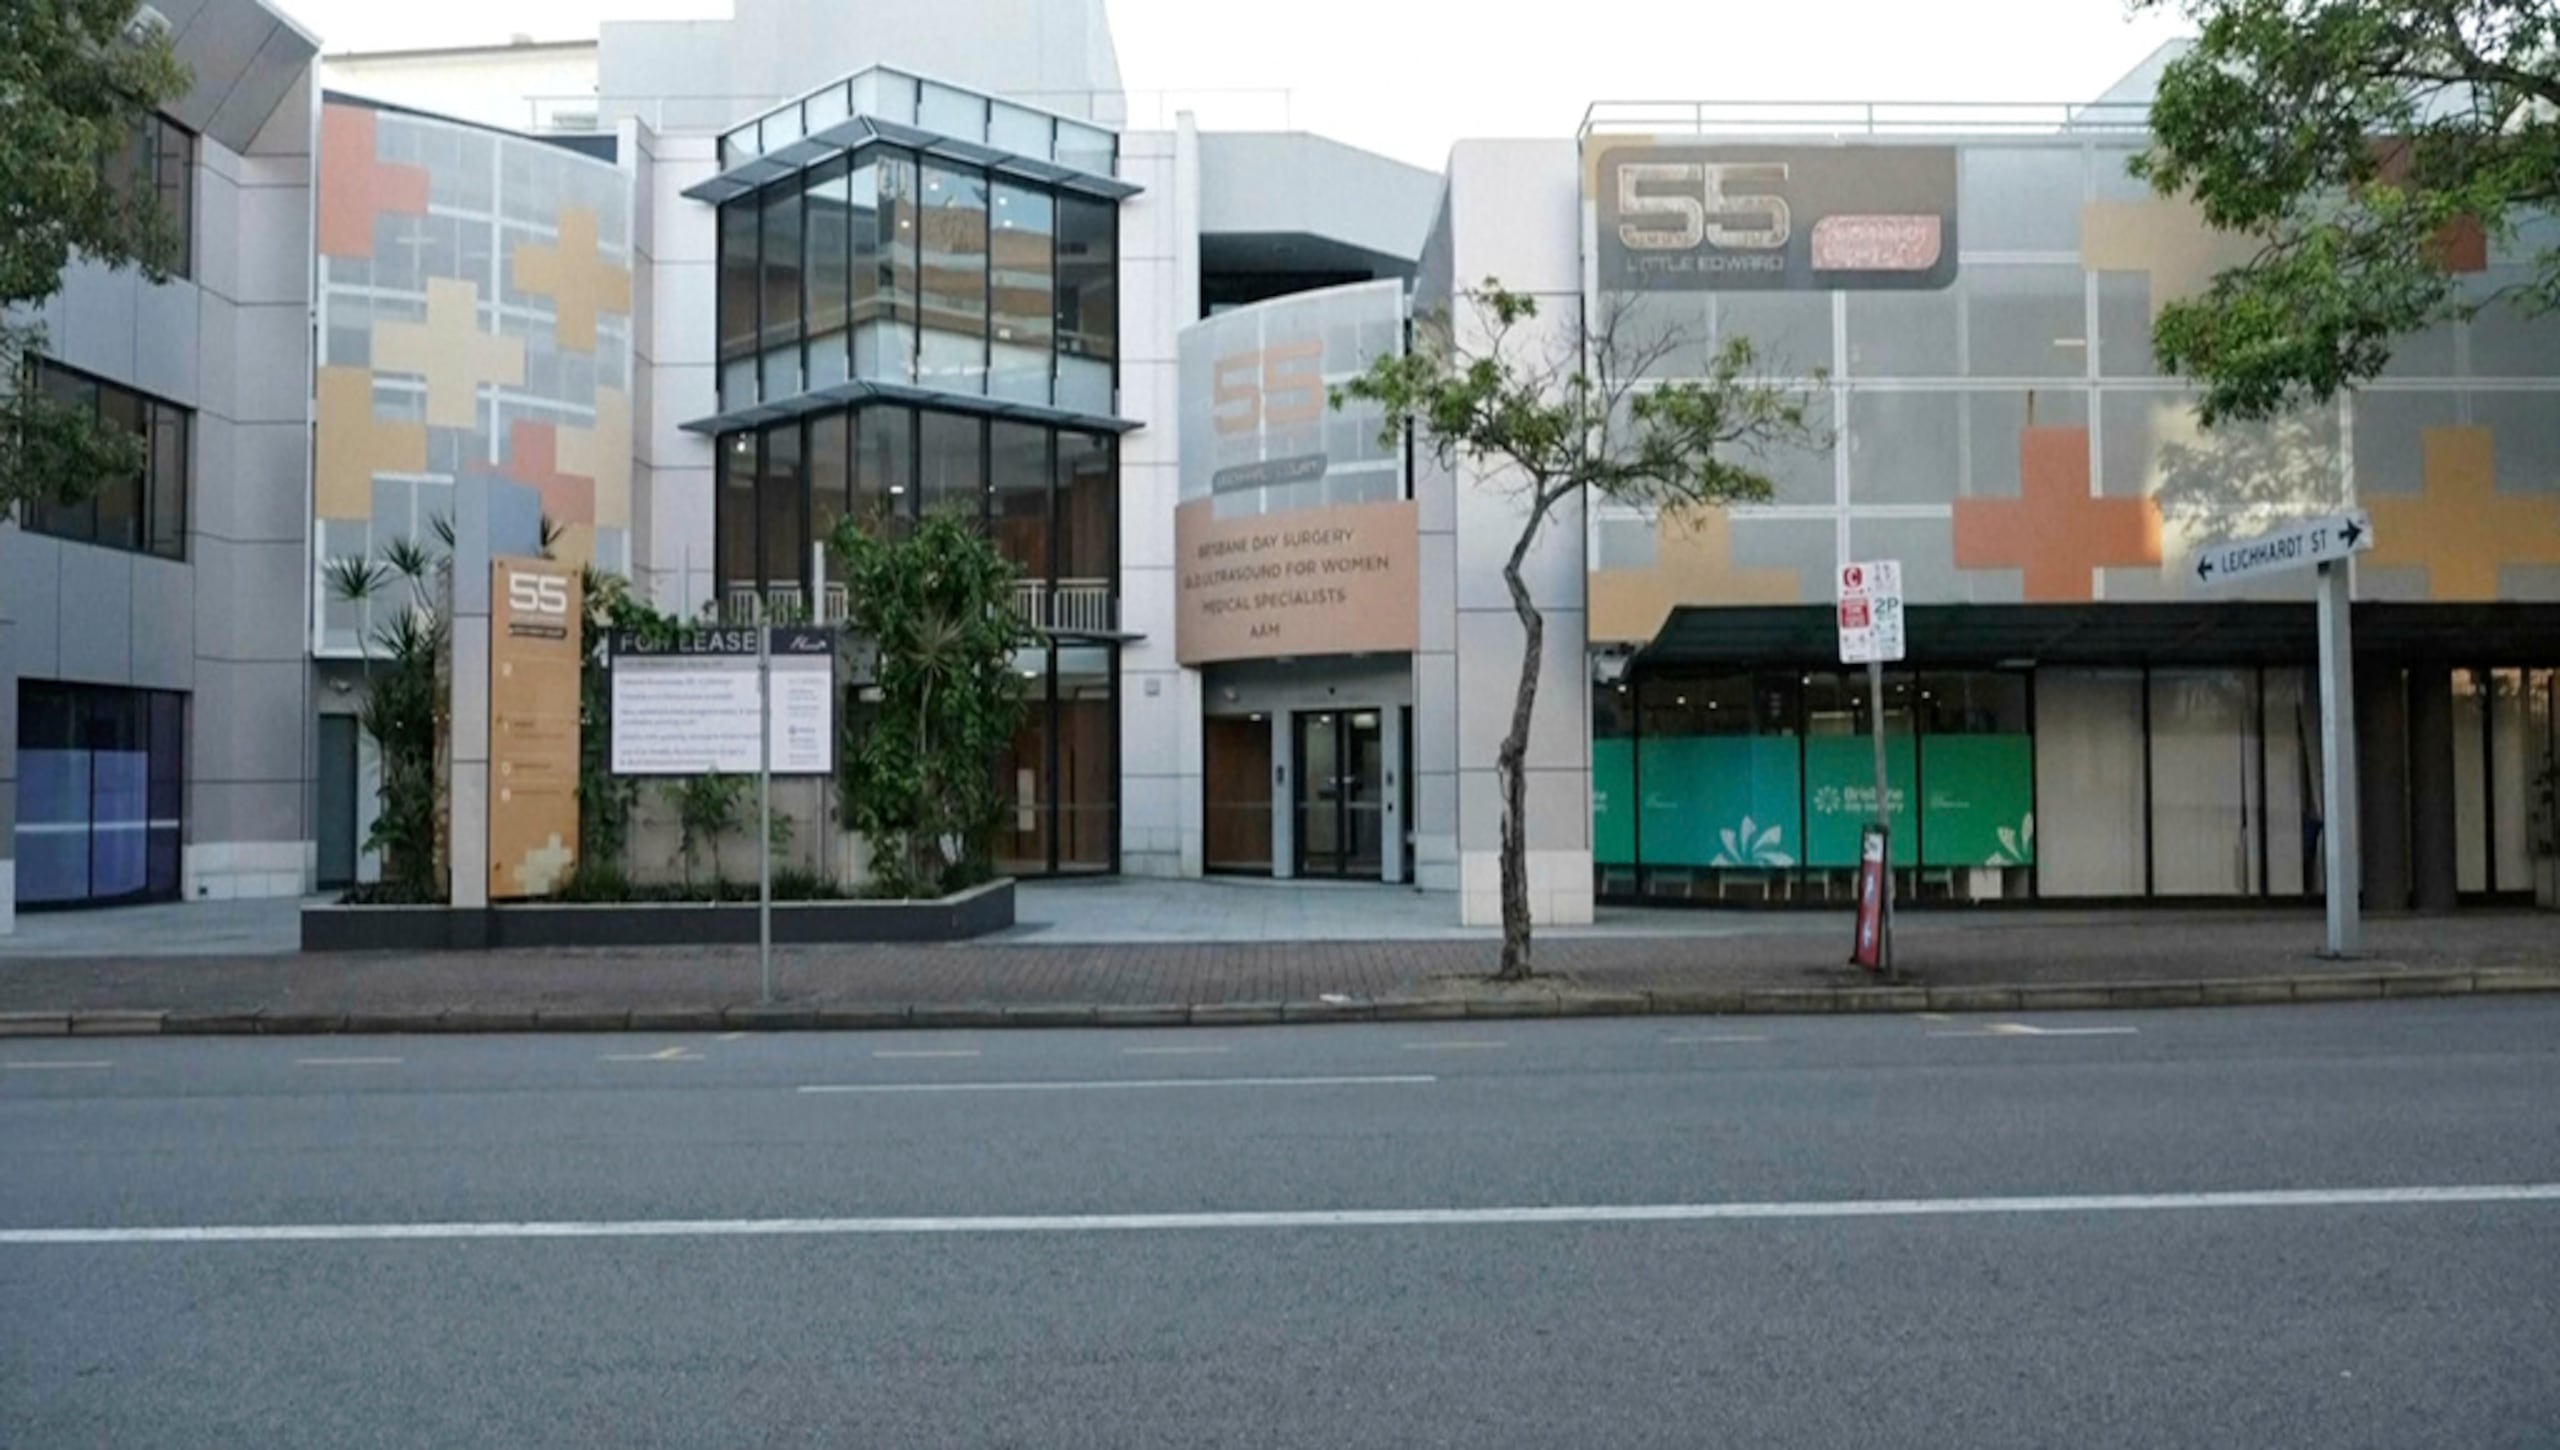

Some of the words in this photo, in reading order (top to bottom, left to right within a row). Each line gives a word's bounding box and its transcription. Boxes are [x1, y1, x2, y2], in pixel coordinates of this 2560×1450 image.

[1617, 162, 1791, 250] 55
[1626, 255, 1693, 272] LITTLE
[1698, 255, 1784, 272] EDWARD
[1213, 339, 1323, 436] 55
[1252, 533, 1279, 552] DAY
[1283, 528, 1355, 548] SURGERY
[2221, 535, 2303, 573] LEICHHARDT
[2311, 529, 2327, 552] ST
[1286, 559, 1316, 576] FOR
[1321, 555, 1389, 574] WOMEN
[508, 571, 568, 614] 55
[1254, 587, 1346, 610] SPECIALISTS
[1874, 597, 1898, 614] 2P
[679, 631, 758, 652] LEASE
